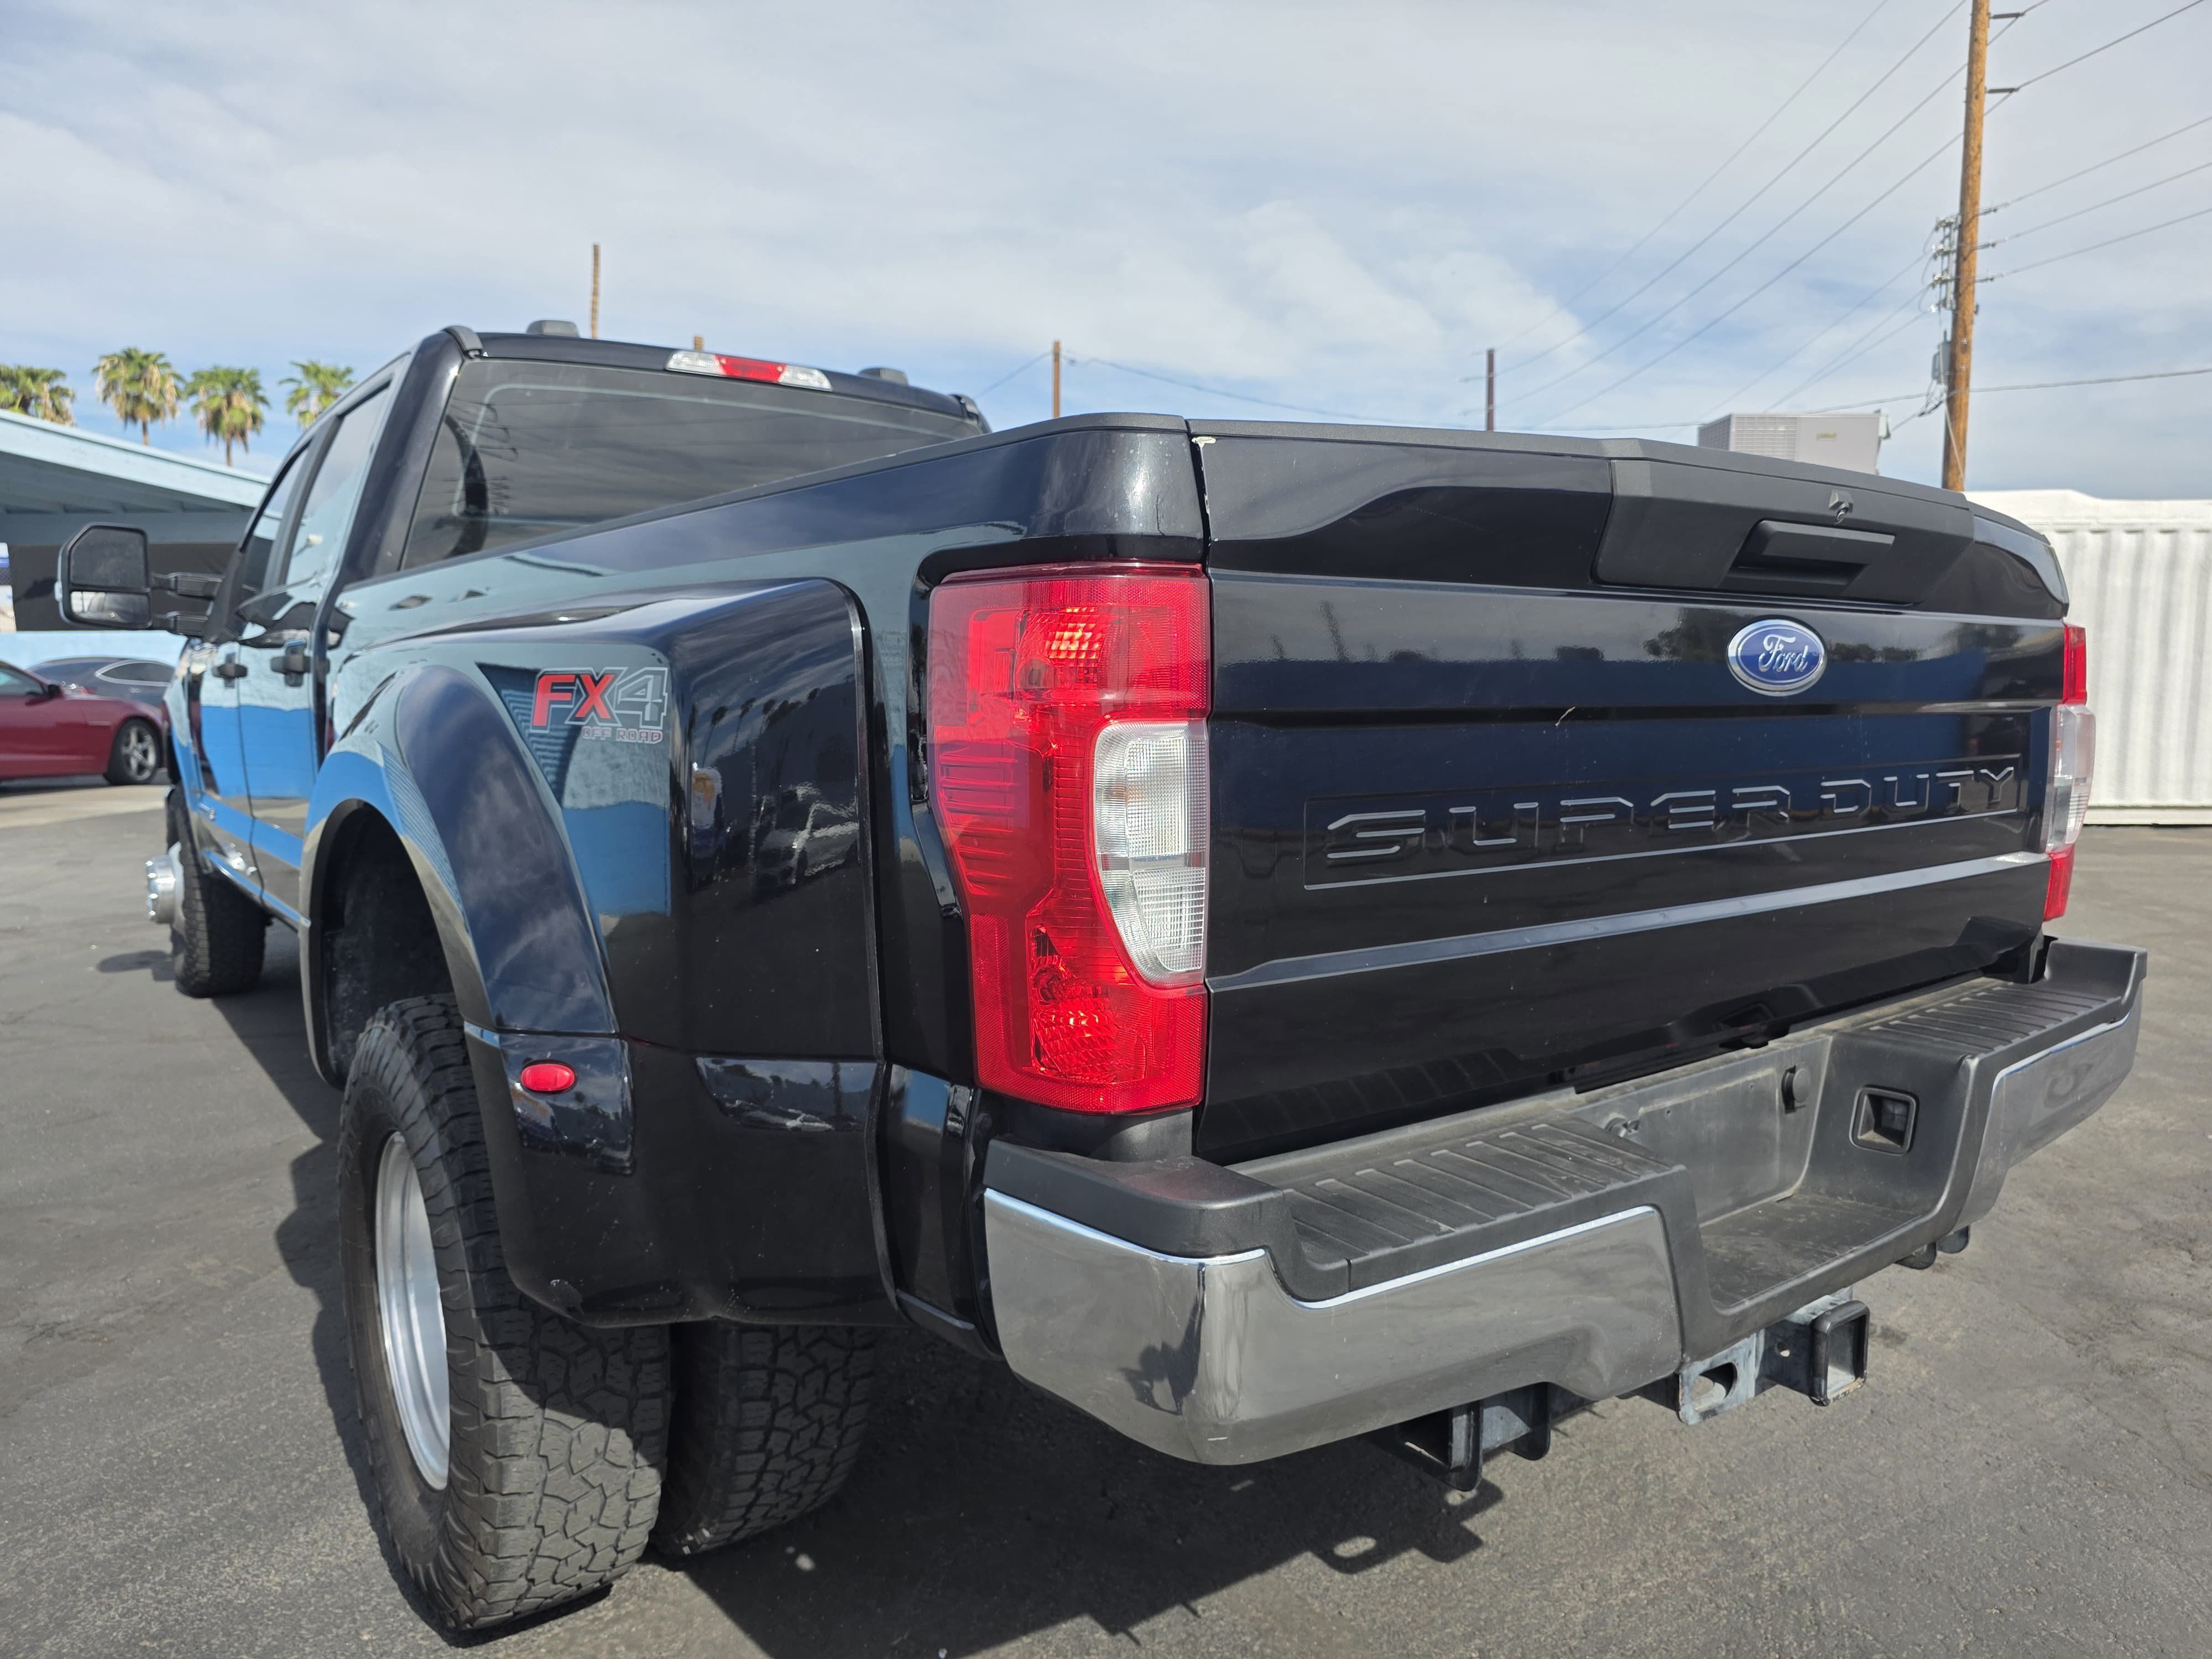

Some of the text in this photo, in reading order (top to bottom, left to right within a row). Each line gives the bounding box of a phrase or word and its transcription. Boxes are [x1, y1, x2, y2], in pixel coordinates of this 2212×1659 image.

[1759, 634, 1809, 672] Ford
[531, 667, 668, 733] FX4
[582, 726, 663, 744] OFF ROAD
[1326, 766, 2015, 866] SUPER DUTY
